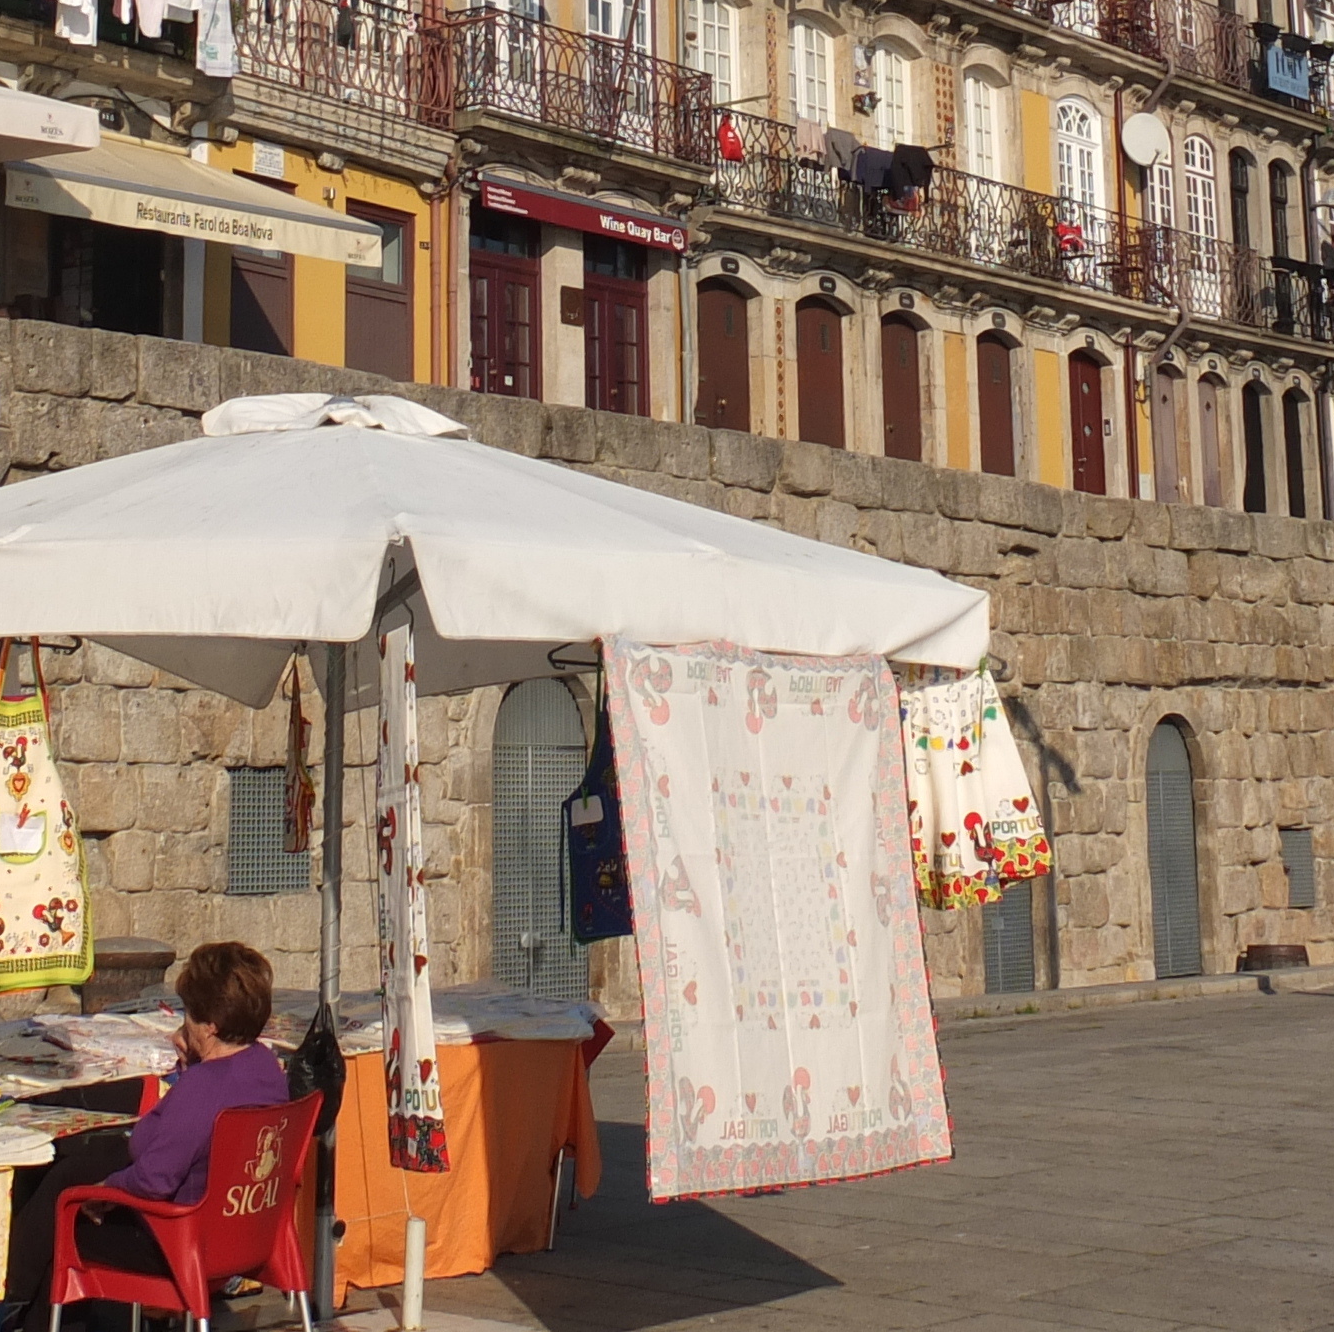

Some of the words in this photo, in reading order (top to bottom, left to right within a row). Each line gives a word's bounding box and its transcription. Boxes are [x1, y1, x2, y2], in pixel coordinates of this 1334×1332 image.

[136, 202, 191, 228] Restaurante
[193, 212, 217, 233] Farol
[218, 217, 230, 234] da
[232, 219, 249, 238] Boa
[250, 222, 274, 242] Nova
[599, 214, 626, 234] Wine
[627, 220, 652, 242] Quay
[653, 226, 672, 244] Bar
[222, 1176, 280, 1217] SICAL
